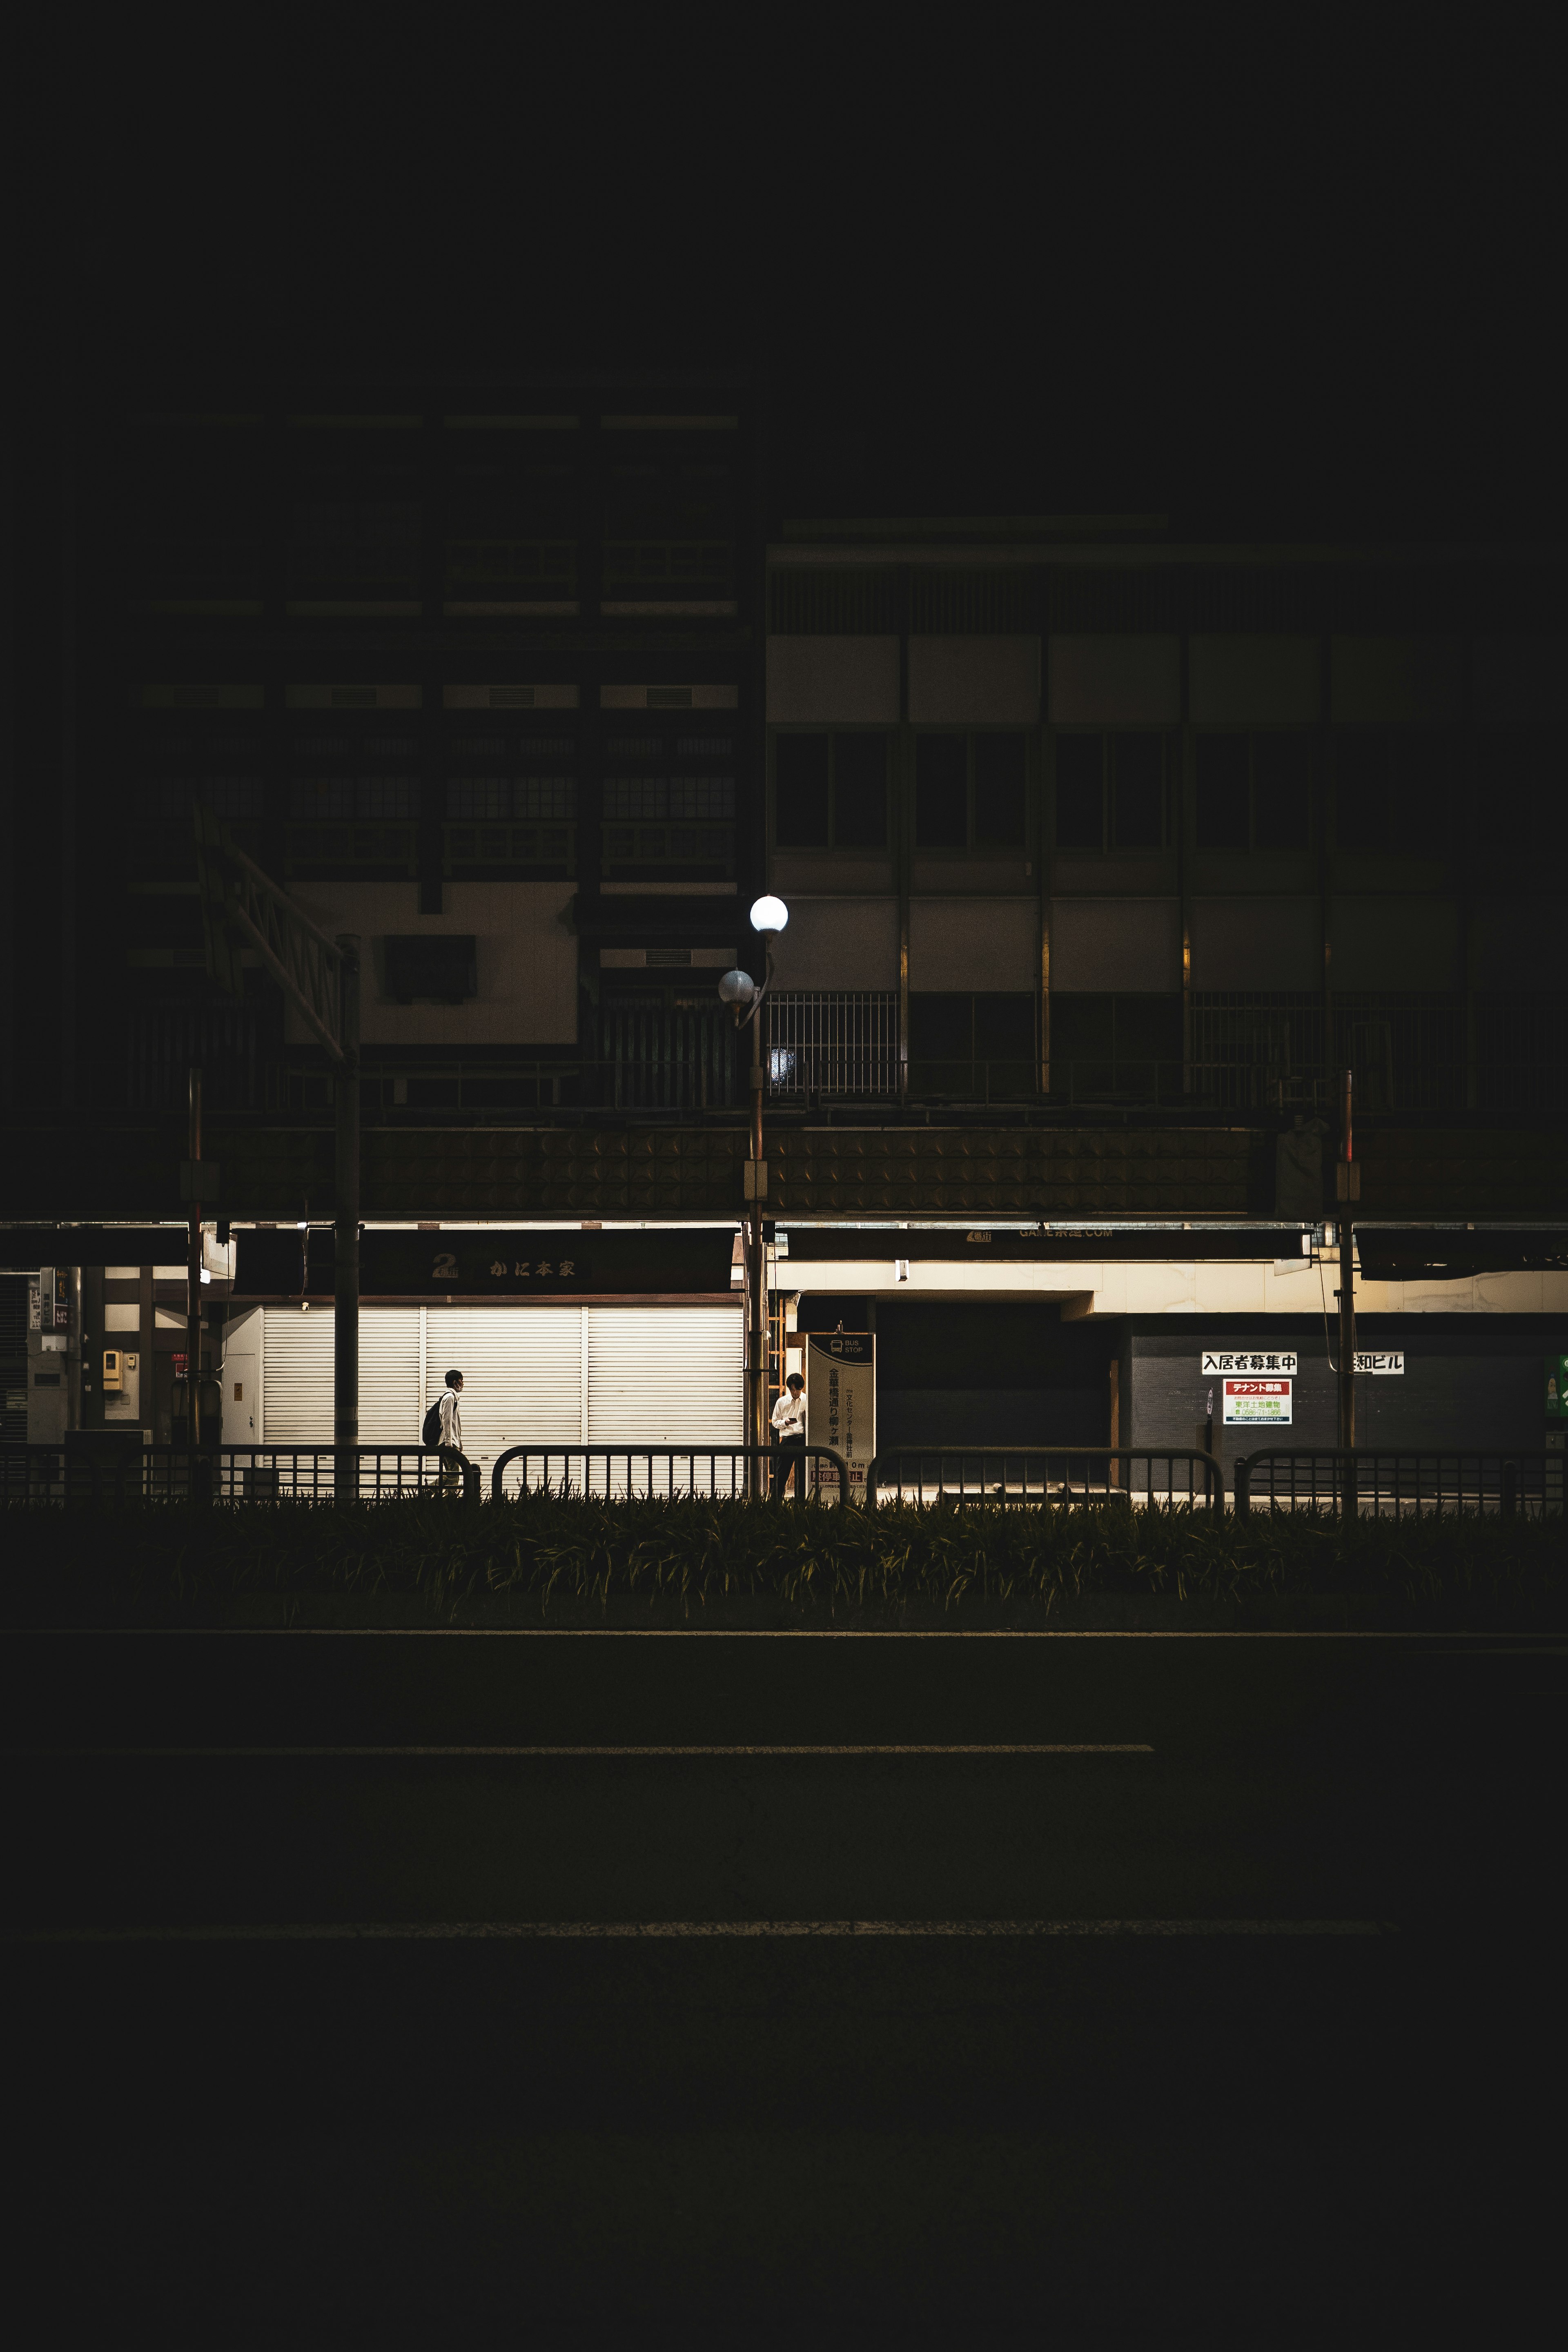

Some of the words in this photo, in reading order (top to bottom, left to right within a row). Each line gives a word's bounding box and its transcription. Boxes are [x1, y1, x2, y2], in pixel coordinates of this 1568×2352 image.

[490, 1260, 575, 1277] かに本家
[1203, 1354, 1296, 1370] 入居者募集中
[1233, 1383, 1283, 1392] テナント募集
[813, 1472, 861, 1481] 駐停車止
